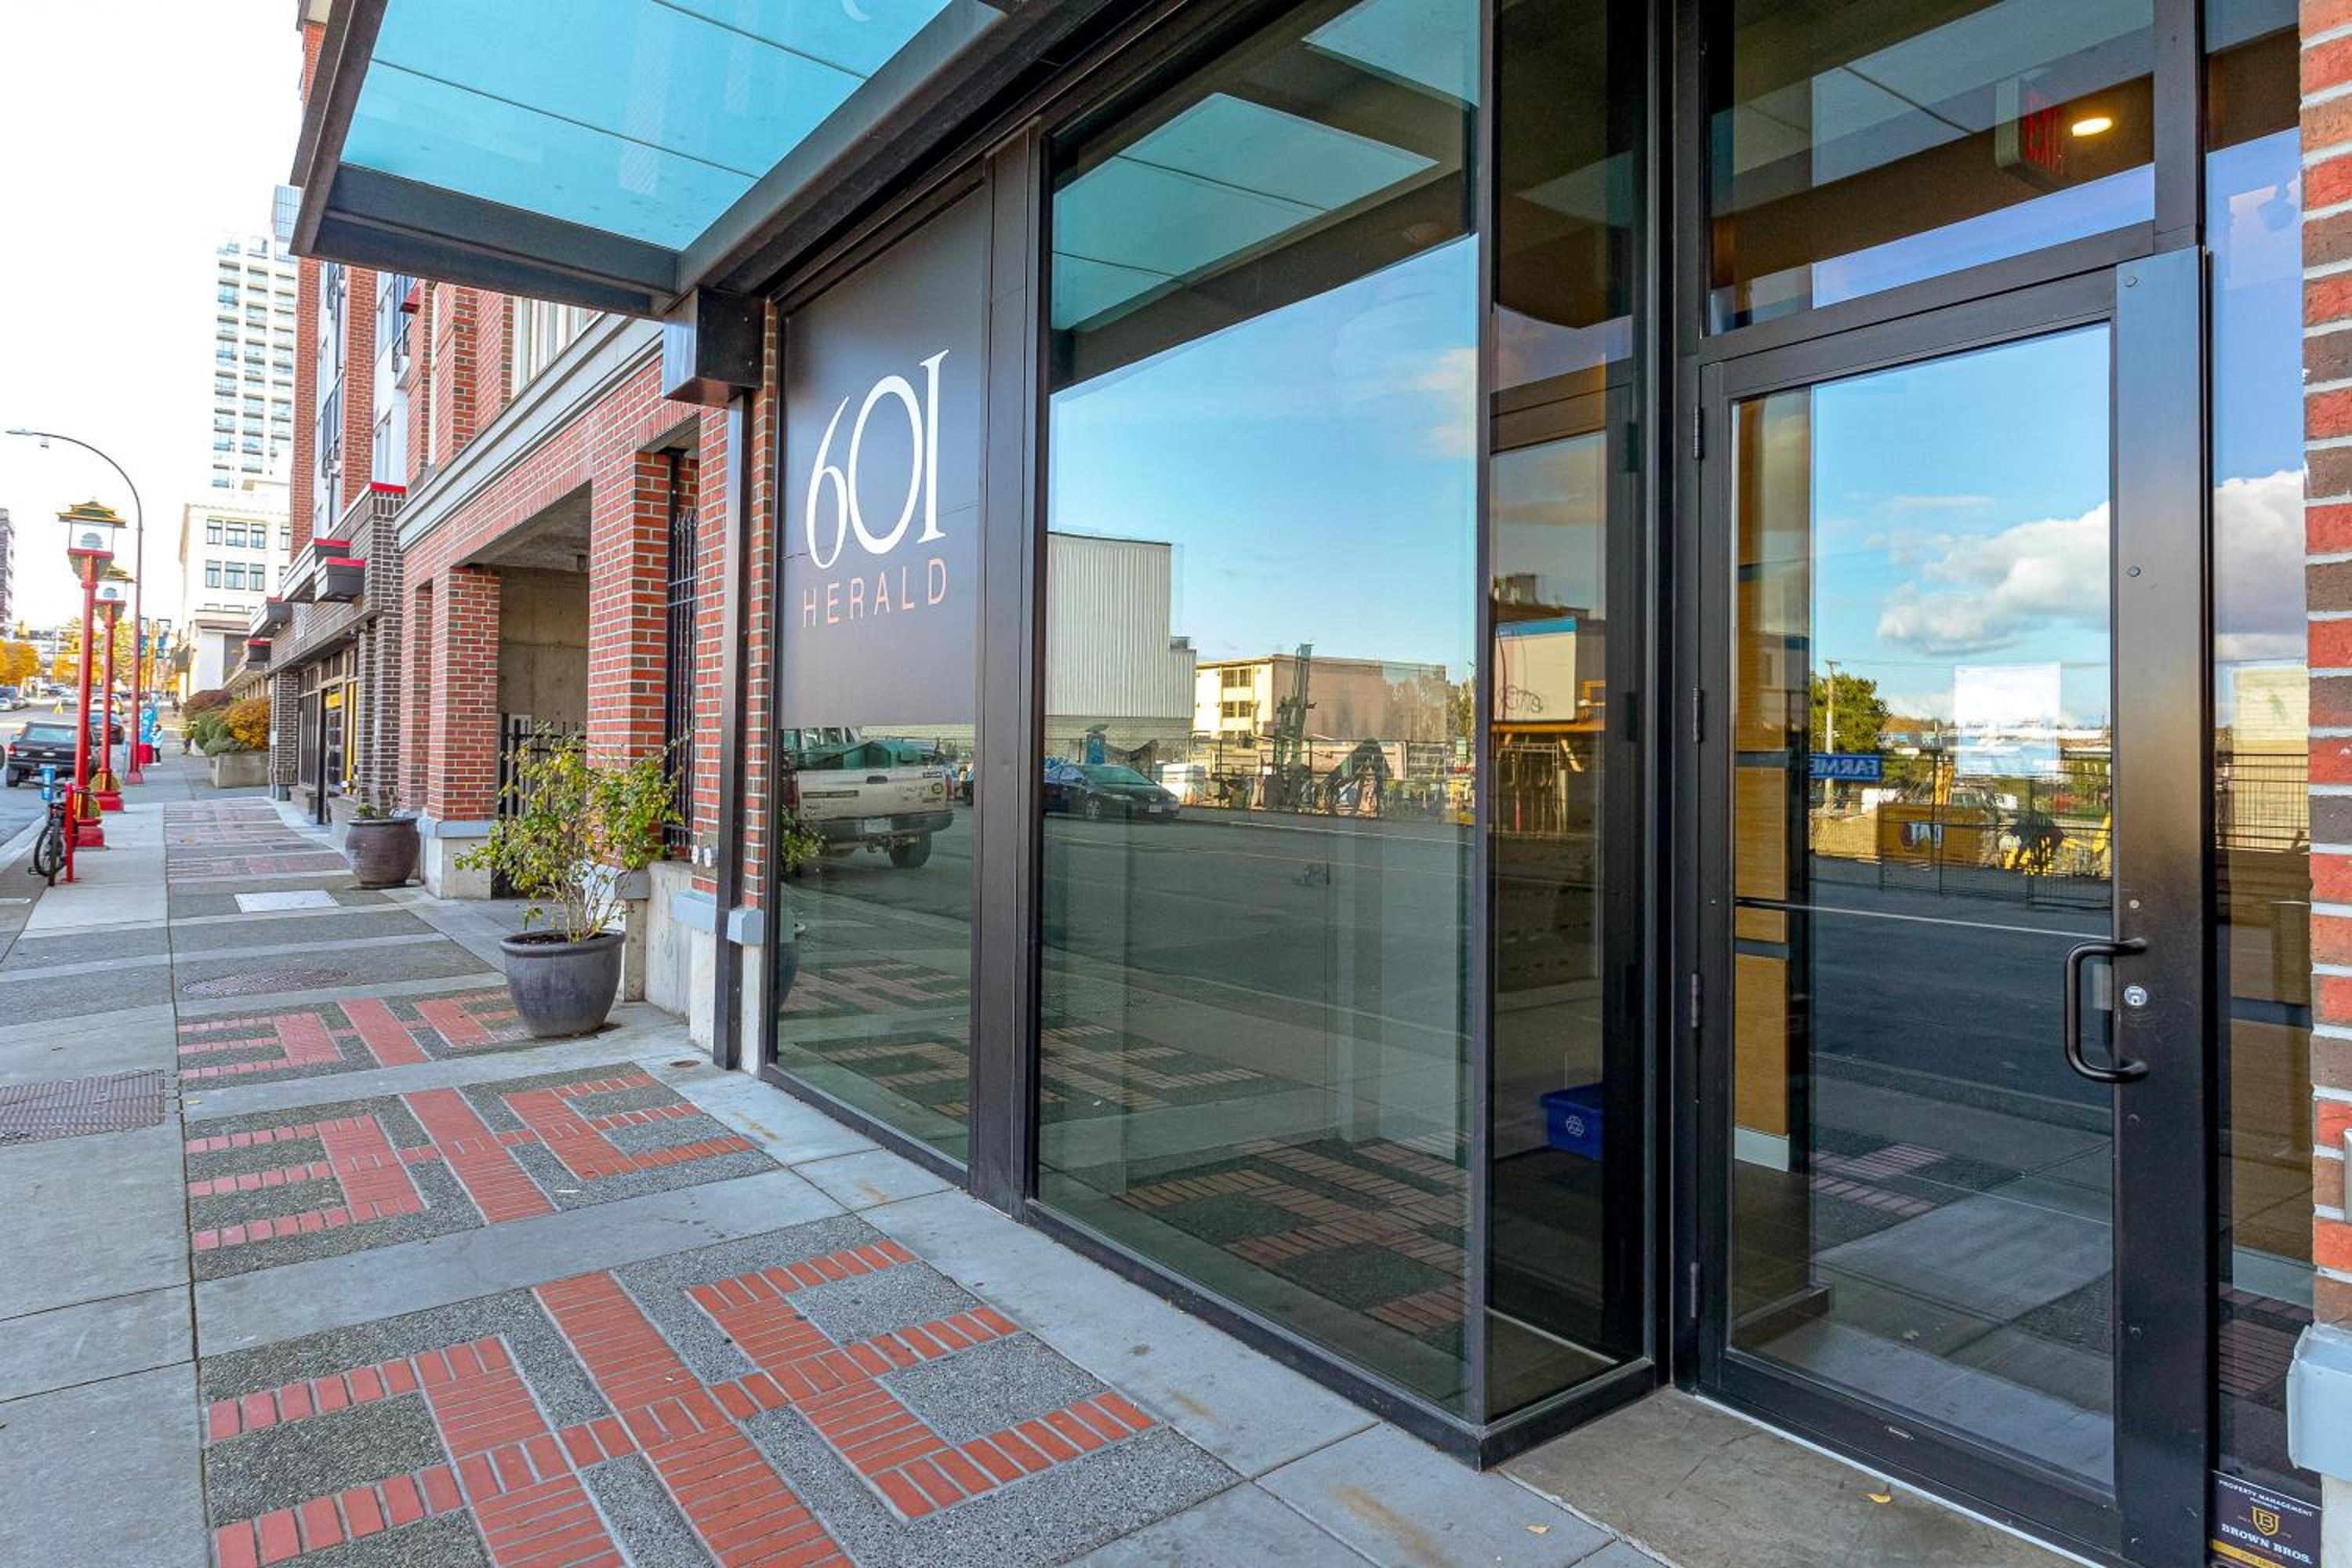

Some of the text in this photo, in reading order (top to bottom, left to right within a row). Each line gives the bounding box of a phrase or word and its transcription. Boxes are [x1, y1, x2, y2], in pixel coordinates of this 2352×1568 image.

[806, 349, 949, 568] 601
[803, 557, 947, 628] HERALD
[2218, 1479, 2256, 1497] PROPERTY
[2259, 1494, 2314, 1517] MANAGEMENT
[2221, 1523, 2270, 1548] BROWN
[2274, 1542, 2313, 1565] BROS.
